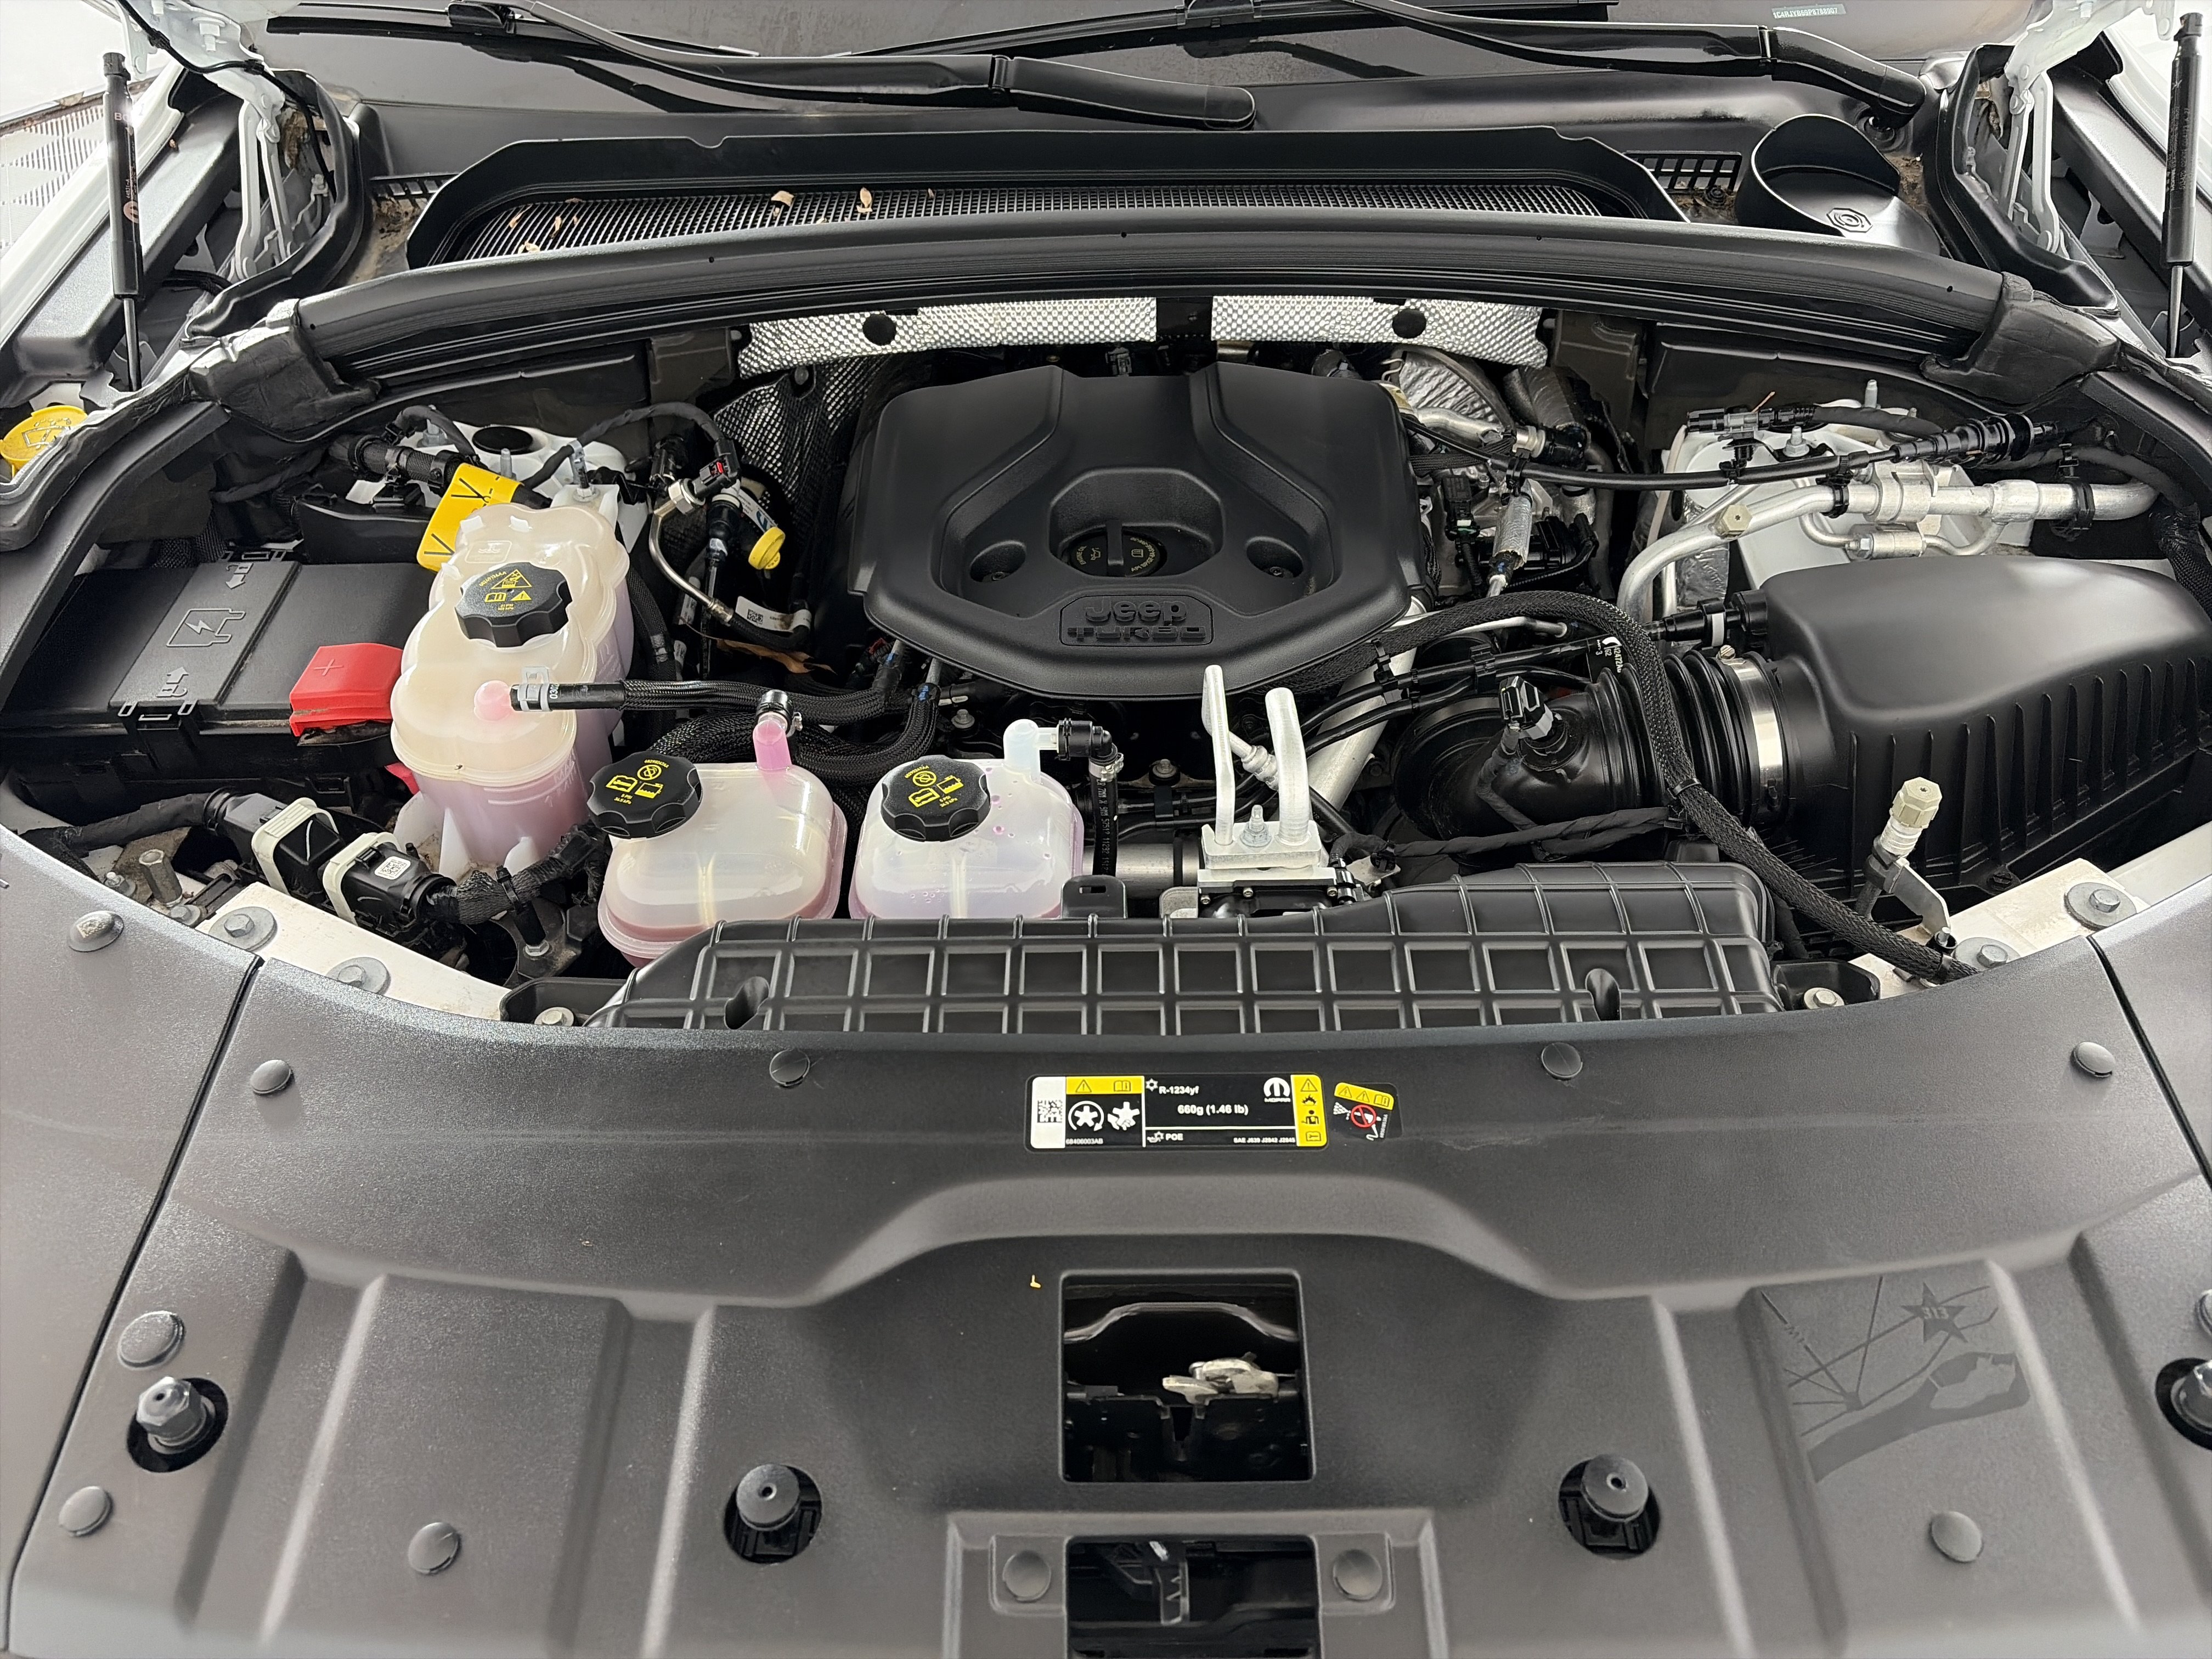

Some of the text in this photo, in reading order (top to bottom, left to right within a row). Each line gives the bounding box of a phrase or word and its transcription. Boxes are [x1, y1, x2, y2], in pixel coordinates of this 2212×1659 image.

[1773, 8, 1838, 19] 1C4RJYB69P8788907
[1076, 552, 1087, 565] ENGINE
[1084, 597, 1187, 625] Jeep
[1067, 625, 1206, 642] TURBO
[1098, 788, 1107, 798] 7MM
[1159, 1086, 1199, 1096] R-1234yf
[1177, 1104, 1249, 1116] 660g (1.46 lb)
[1922, 1306, 1949, 1319] 313
